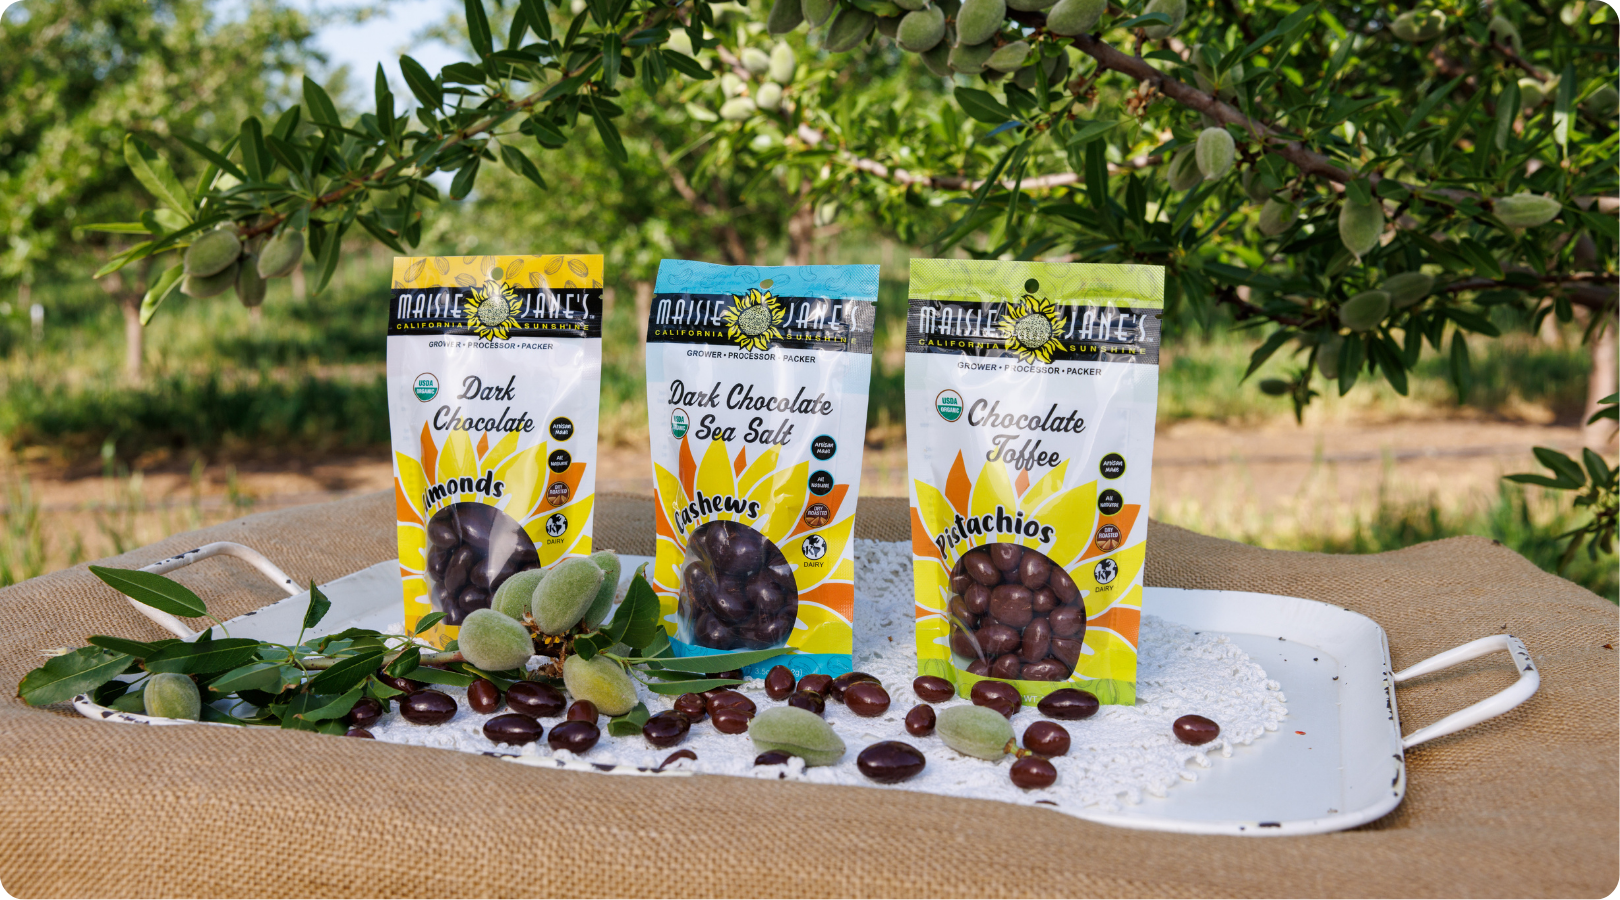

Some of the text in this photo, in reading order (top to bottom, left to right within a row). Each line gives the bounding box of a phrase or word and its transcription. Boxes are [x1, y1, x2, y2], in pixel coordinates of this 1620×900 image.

[397, 293, 463, 319] MAISIE
[520, 292, 589, 320] JANE'S
[656, 299, 724, 326] MAISIE
[782, 302, 859, 332] JANES
[396, 322, 589, 330] CALIFORNIA SUNSHINE
[655, 329, 857, 344] CALIFORNIA SUNSHINE
[918, 306, 1148, 342] MAISIE JANE'S
[686, 350, 816, 363] GROWER PROCESSOR PACKER
[918, 338, 1146, 354] CALIFORNIA SUNSHINE
[958, 362, 1102, 376] GROWER PROCESSOR PACKER
[457, 375, 516, 401] Dark
[668, 379, 834, 416] Dark Chocolate
[434, 405, 535, 432] Chocolate
[696, 414, 794, 446] Sea Salt
[968, 398, 1086, 434] Chocolate
[986, 434, 1062, 472] Toffee
[422, 470, 504, 513] lmonds
[674, 491, 760, 534] Cashews
[936, 506, 1054, 560] Pistachios
